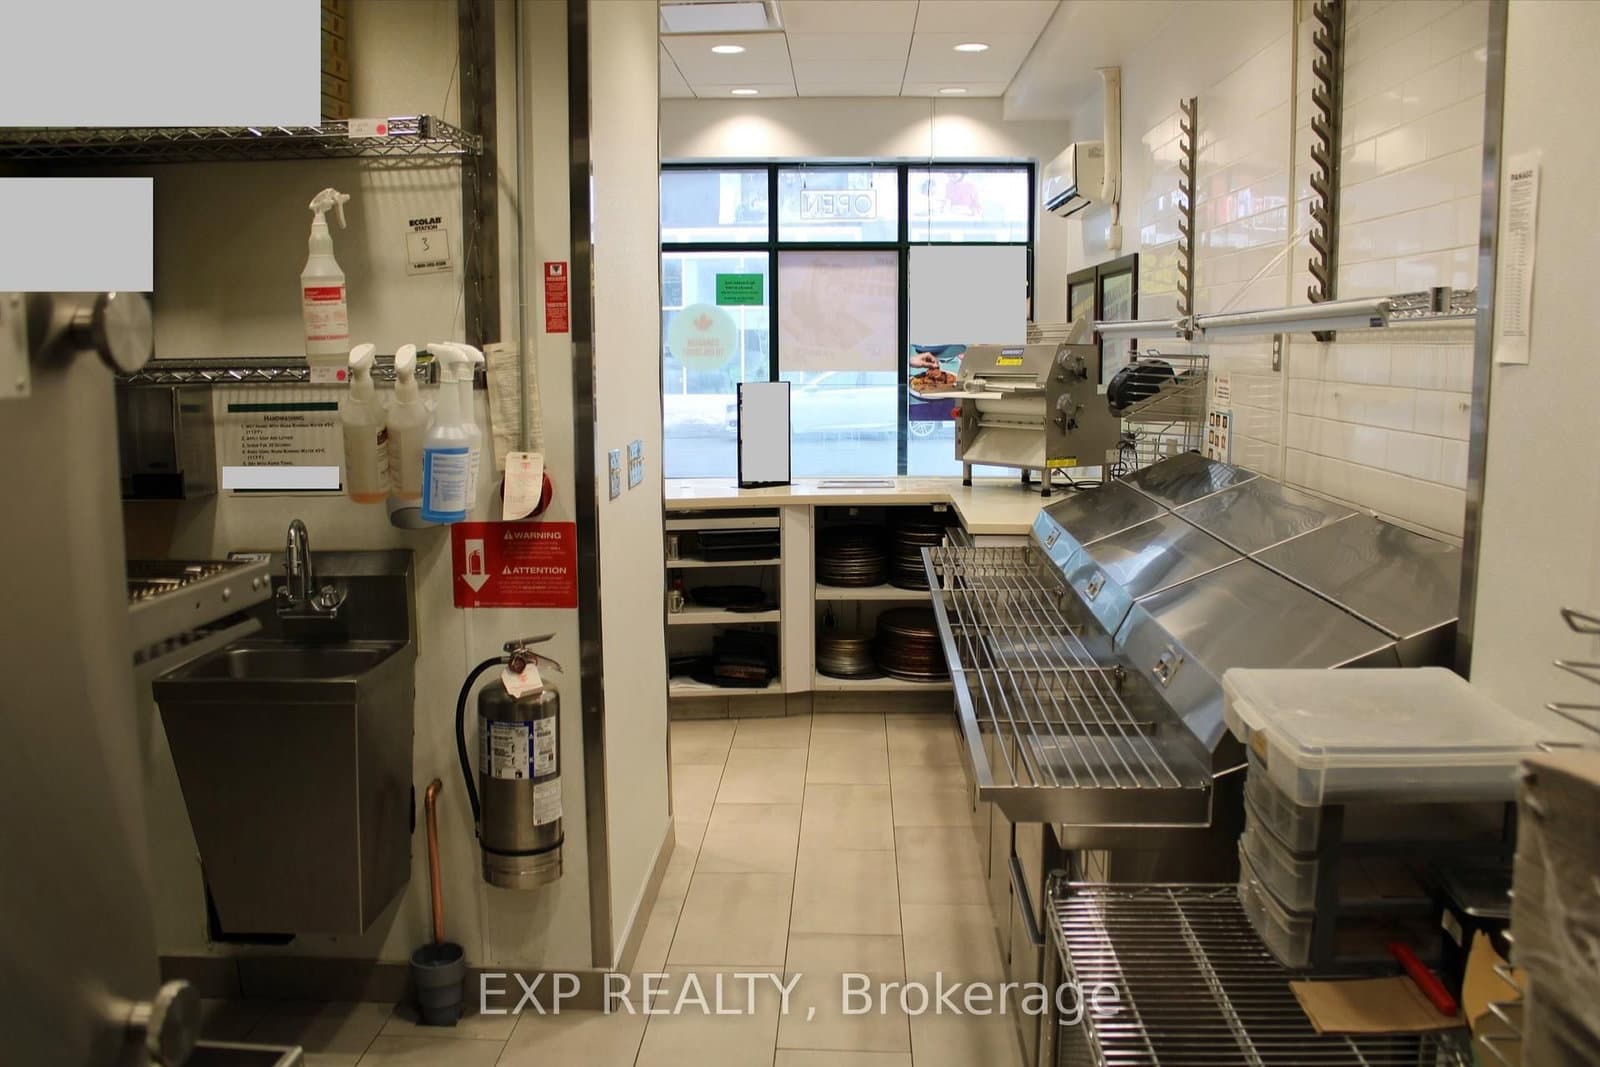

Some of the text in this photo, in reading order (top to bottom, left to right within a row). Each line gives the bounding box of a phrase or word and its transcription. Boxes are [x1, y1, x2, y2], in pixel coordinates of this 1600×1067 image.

[408, 216, 442, 227] ECOLAB
[421, 237, 430, 252] 3
[513, 531, 562, 540] WARNING
[512, 566, 567, 575] ATTENTION
